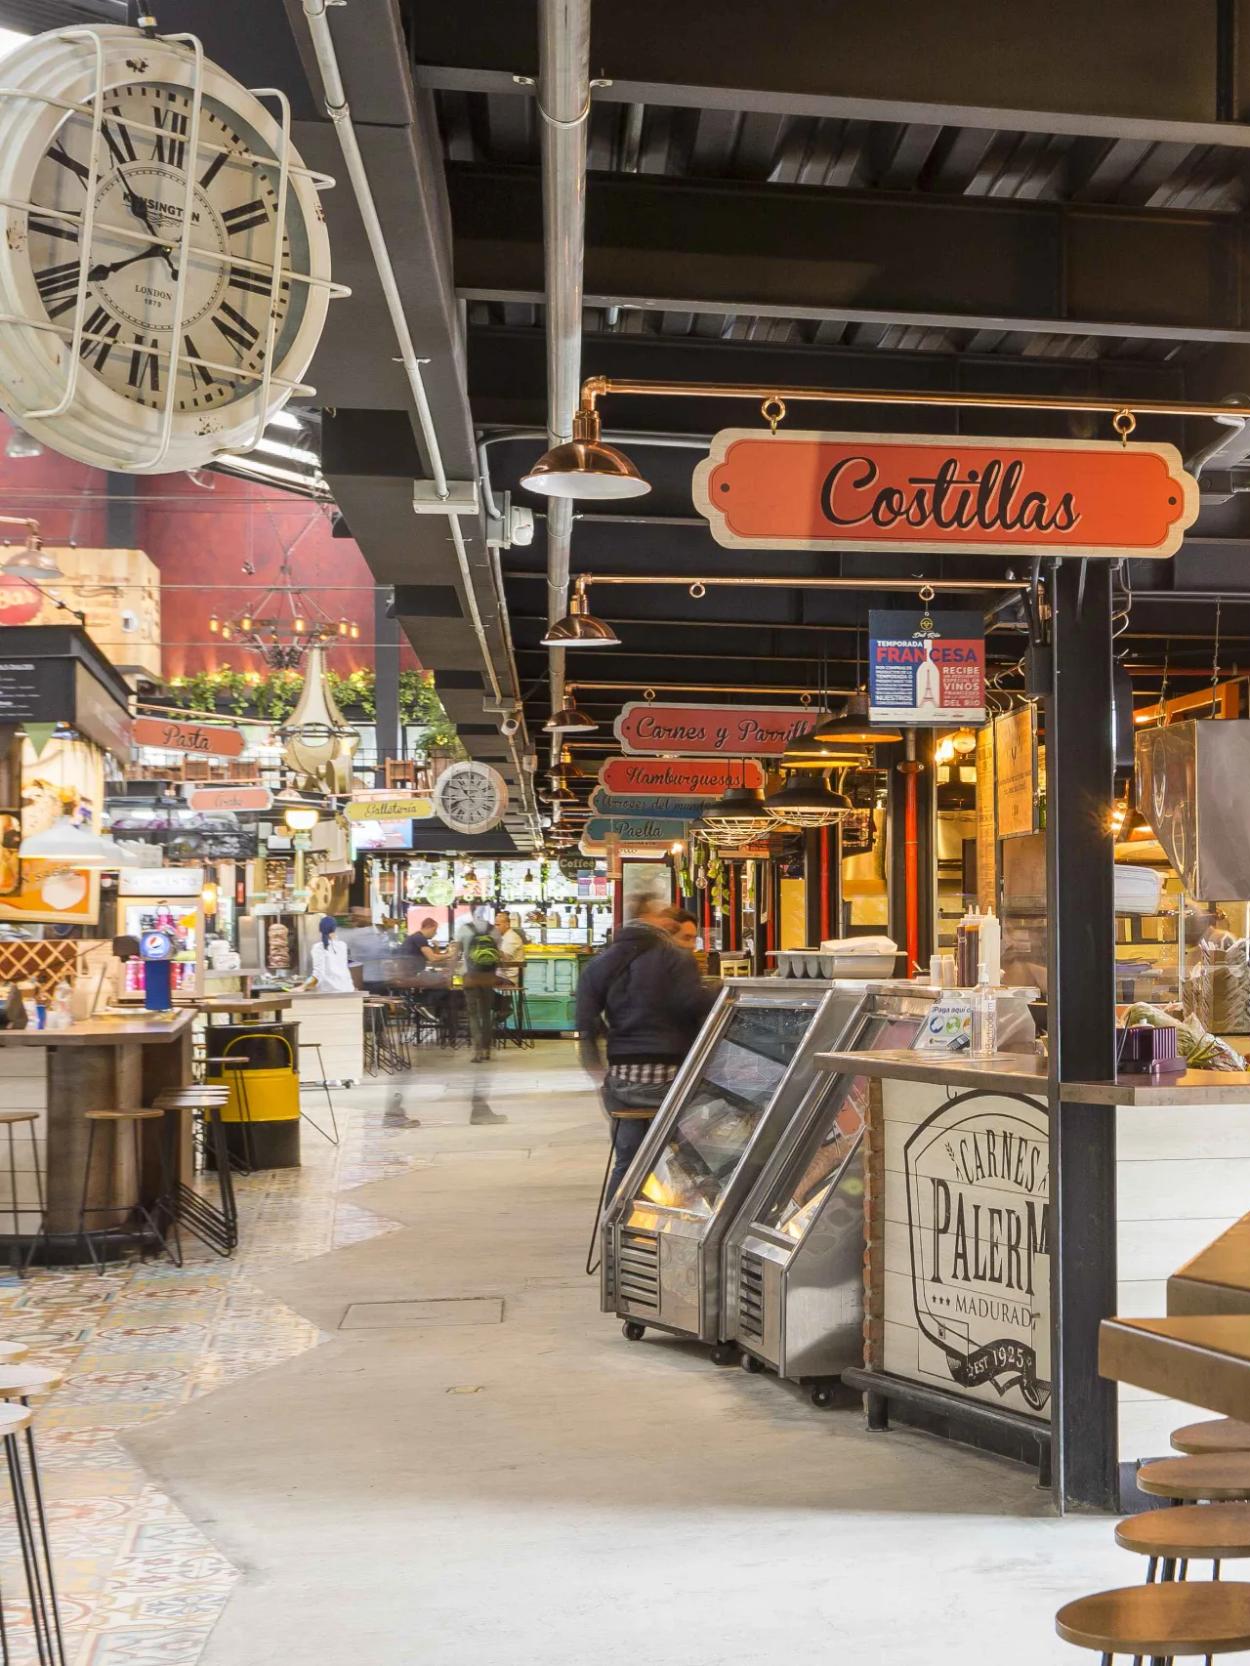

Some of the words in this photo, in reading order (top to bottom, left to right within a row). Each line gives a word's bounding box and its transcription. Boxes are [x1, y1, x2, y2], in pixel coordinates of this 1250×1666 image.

[123, 192, 200, 222] KSINGTN
[135, 284, 172, 300] LONDON
[820, 456, 1081, 532] Costillas
[876, 647, 977, 663] FRANCESA
[162, 724, 211, 750] Pasta
[636, 716, 706, 741] Carnes
[713, 728, 729, 748] y
[737, 719, 808, 744] Parrill
[625, 766, 744, 792] Hamburguesas
[615, 821, 664, 838] Paella
[559, 858, 596, 870] Coffee
[960, 1129, 1041, 1193] CARNES
[931, 1178, 1050, 1296] PALERM
[955, 1293, 1035, 1330] MADURAD
[974, 1356, 989, 1374] EST
[993, 1346, 1024, 1368] 1925
